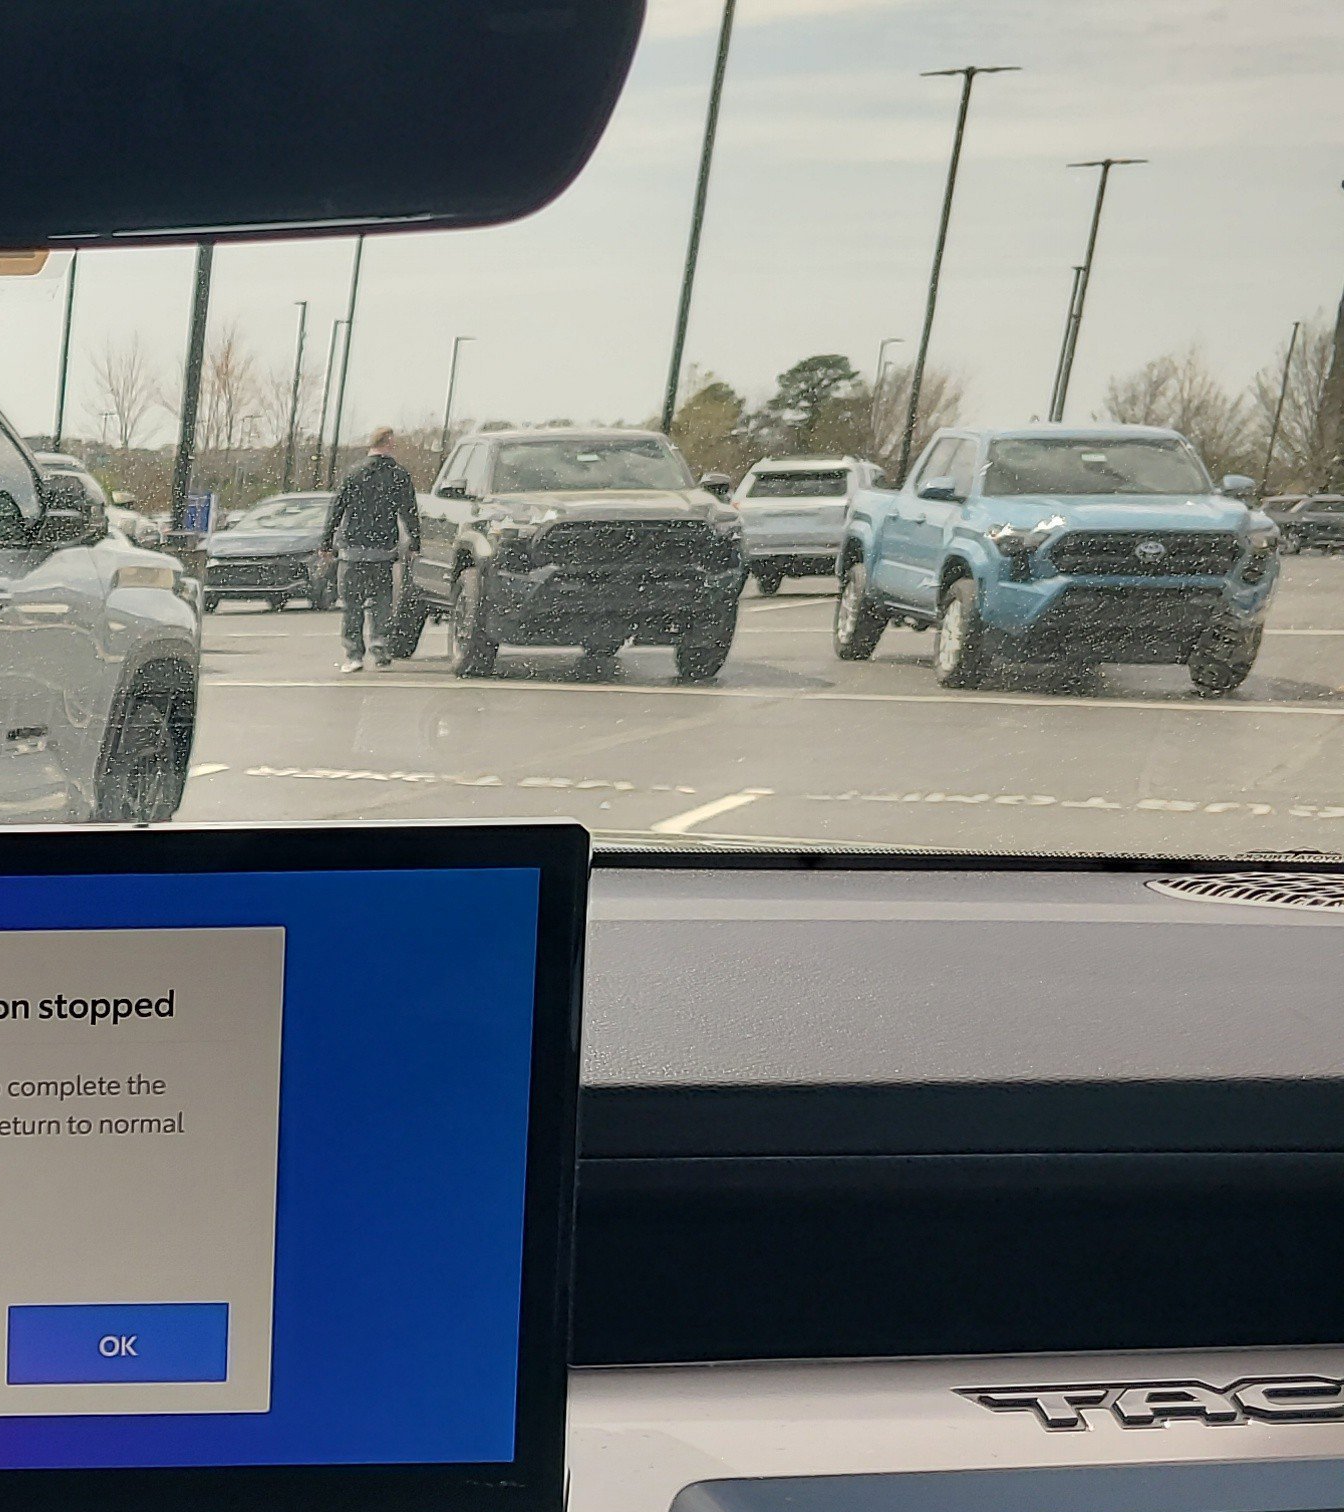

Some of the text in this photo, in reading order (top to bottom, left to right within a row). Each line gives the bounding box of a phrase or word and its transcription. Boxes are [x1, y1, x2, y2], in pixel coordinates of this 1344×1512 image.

[38, 989, 176, 1025] stopped
[7, 1073, 121, 1101] complete
[127, 1072, 166, 1096] the
[67, 1114, 92, 1135] to
[99, 1111, 184, 1135] normal
[98, 1335, 138, 1357] OK
